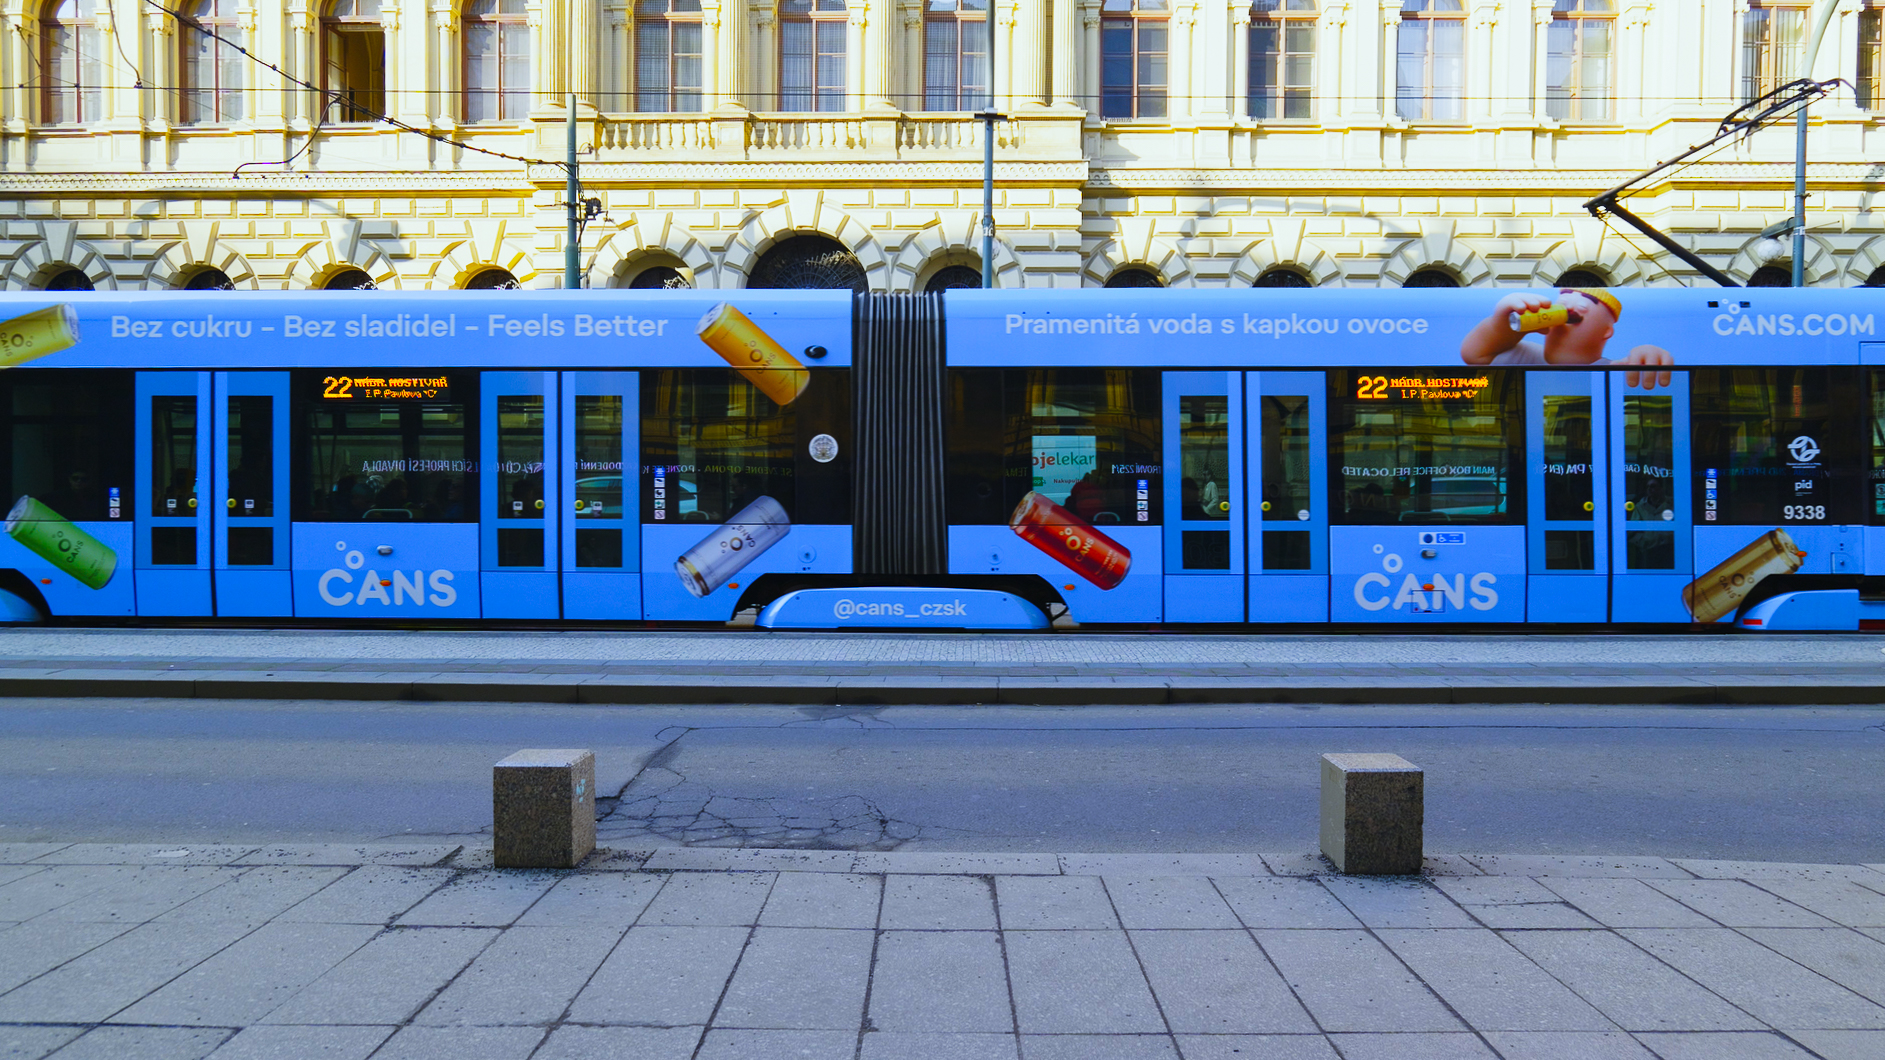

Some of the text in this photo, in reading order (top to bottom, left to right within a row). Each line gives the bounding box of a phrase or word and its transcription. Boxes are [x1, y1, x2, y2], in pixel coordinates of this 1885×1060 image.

[112, 315, 162, 338] Bez
[171, 315, 252, 338] cukru
[284, 314, 336, 338] Bez
[345, 313, 456, 338] sladidel
[488, 312, 565, 337] Feels
[574, 313, 669, 338] Better
[1005, 313, 1428, 339] Pramenitá voda s kapkou ovoce
[1712, 313, 1875, 336] CANS.COM
[0, 332, 13, 357] CANS
[322, 376, 353, 399] 22
[1356, 376, 1388, 399] 22
[1794, 479, 1813, 491] pid
[1783, 505, 1826, 520] 9338
[736, 525, 757, 548] CANS
[66, 540, 85, 564] CANS
[1075, 537, 1095, 562] CANS
[318, 568, 457, 607] CANS
[1353, 571, 1499, 611] CANS
[1719, 575, 1737, 599] CANS
[833, 598, 967, 620] @cans_czsk
